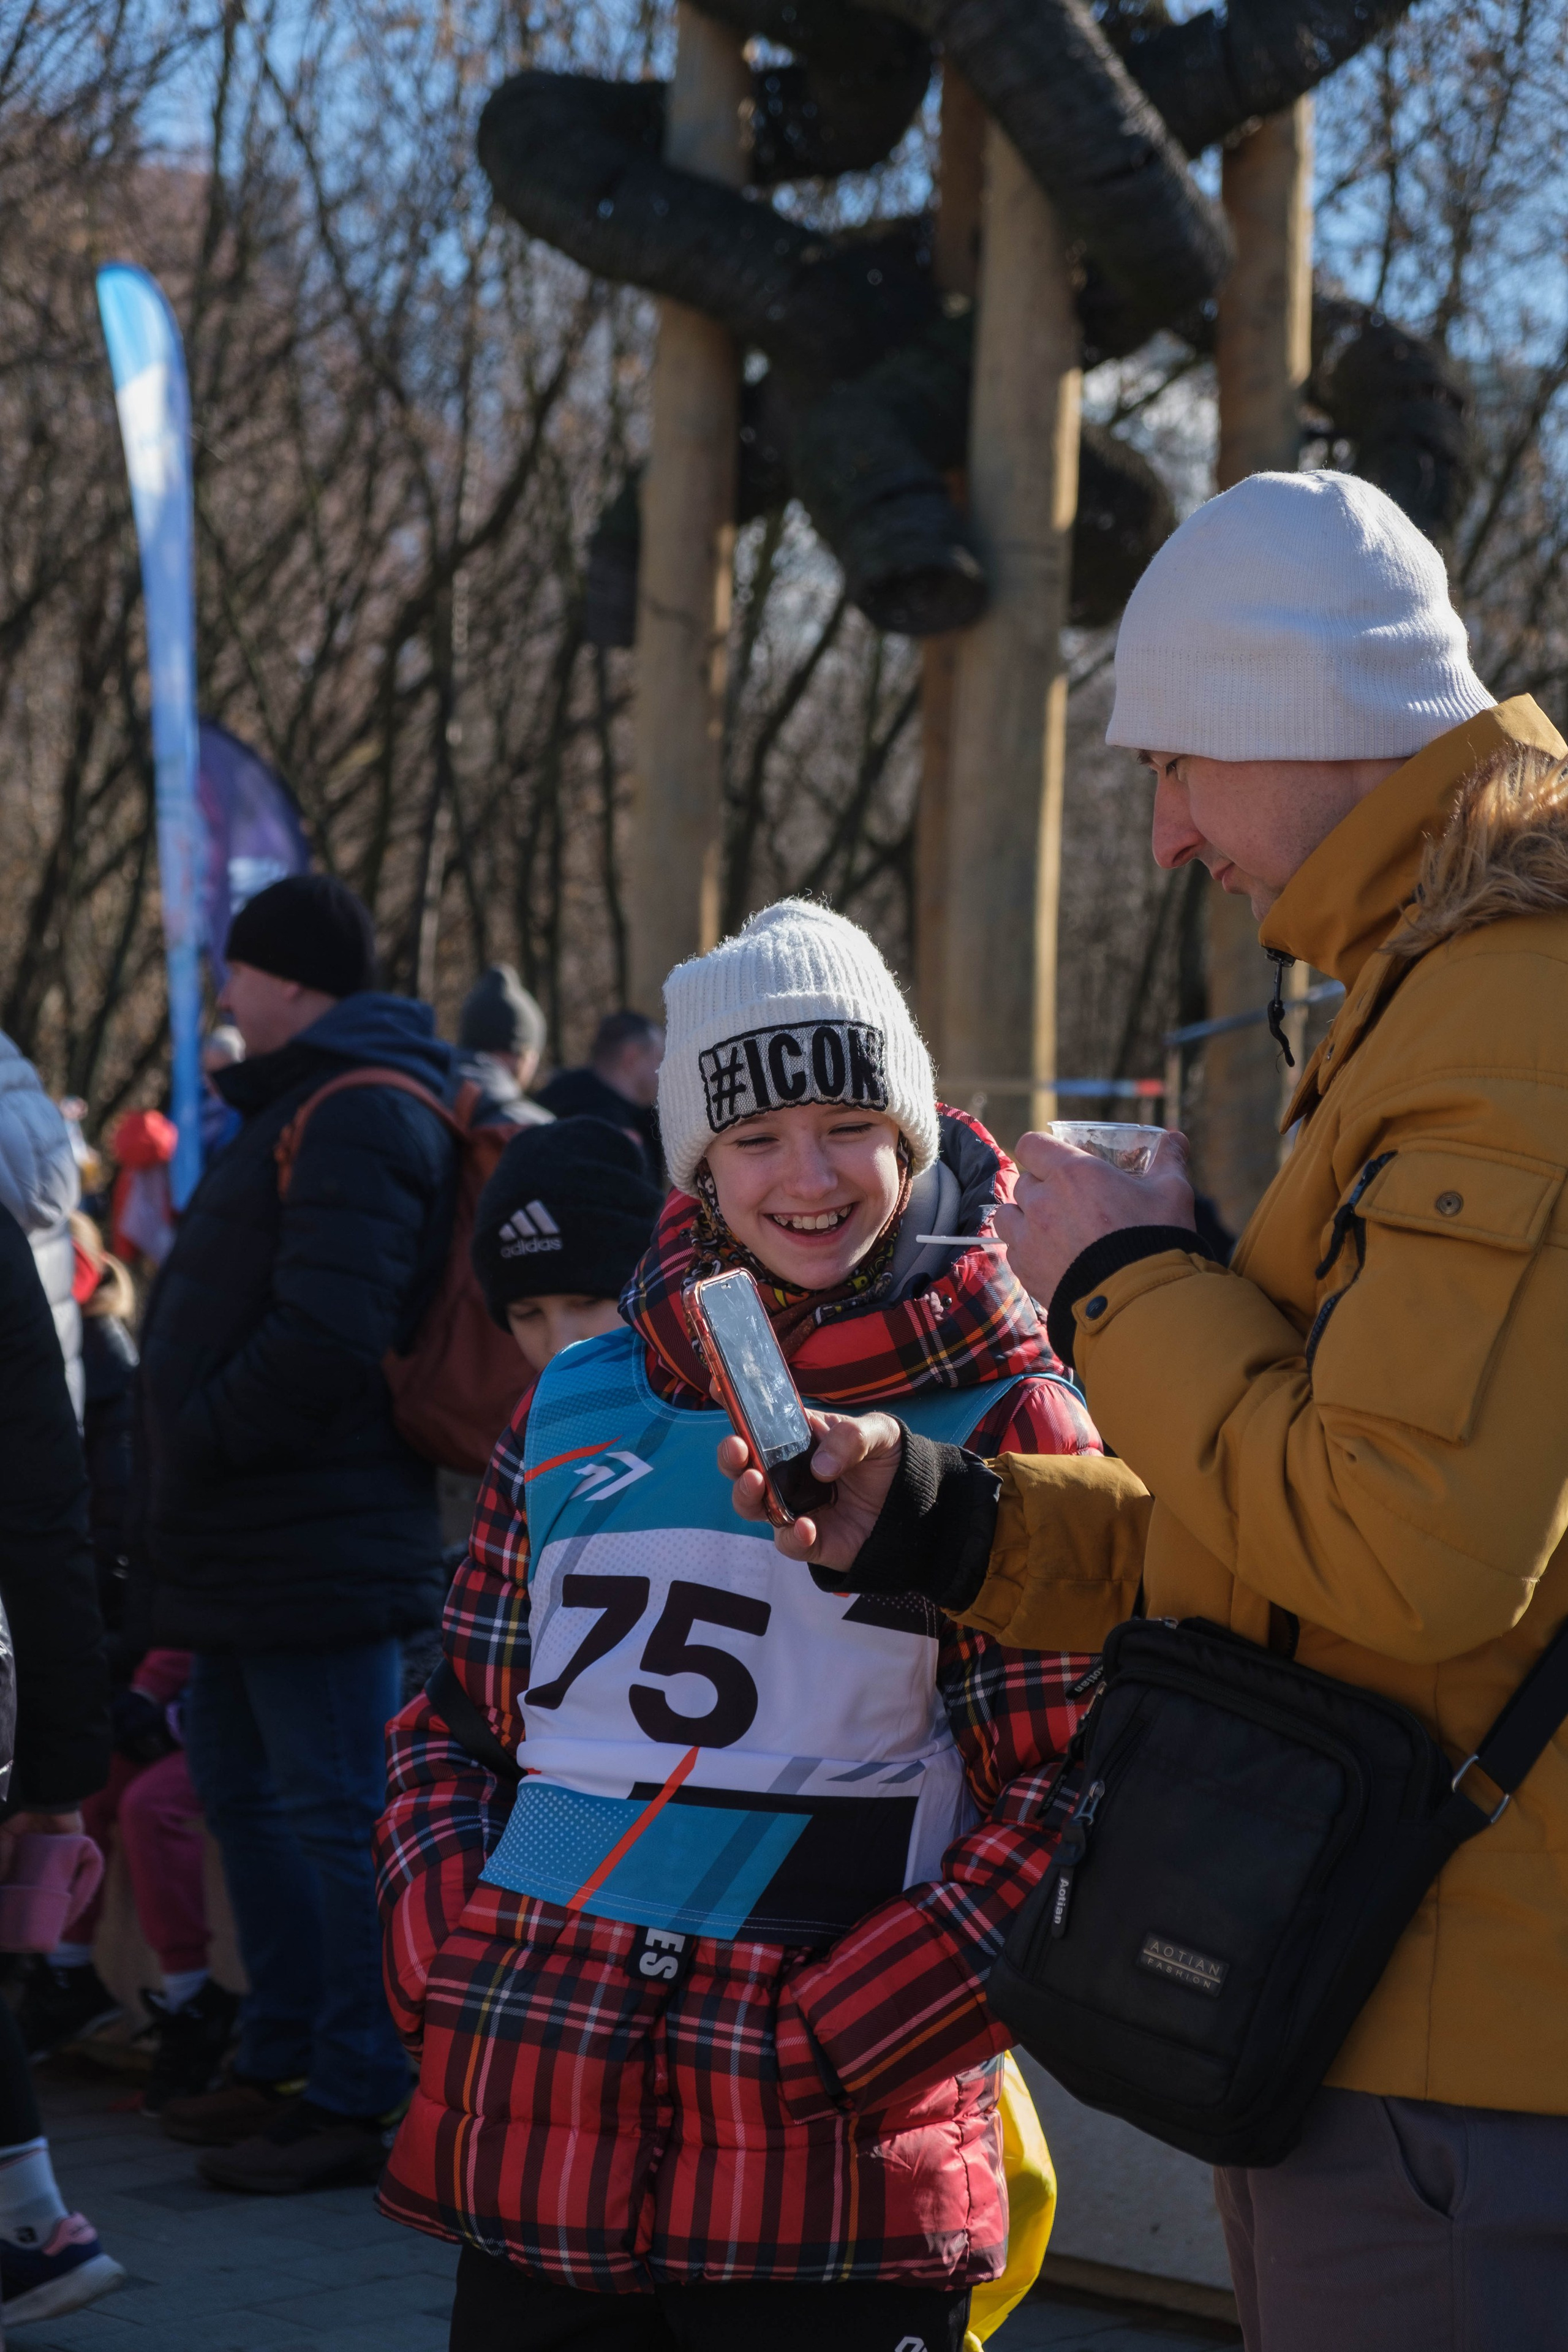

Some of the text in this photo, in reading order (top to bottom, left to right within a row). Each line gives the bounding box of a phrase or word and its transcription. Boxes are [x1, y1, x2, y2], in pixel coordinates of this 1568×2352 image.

[709, 1026, 881, 1120] #ICON
[500, 1237, 562, 1258] adidas
[524, 1574, 771, 1749] 75
[1054, 1877, 1069, 1924] Aotian
[1147, 1958, 1212, 1989] FASHION
[1150, 1940, 1220, 1977] AOTIAN
